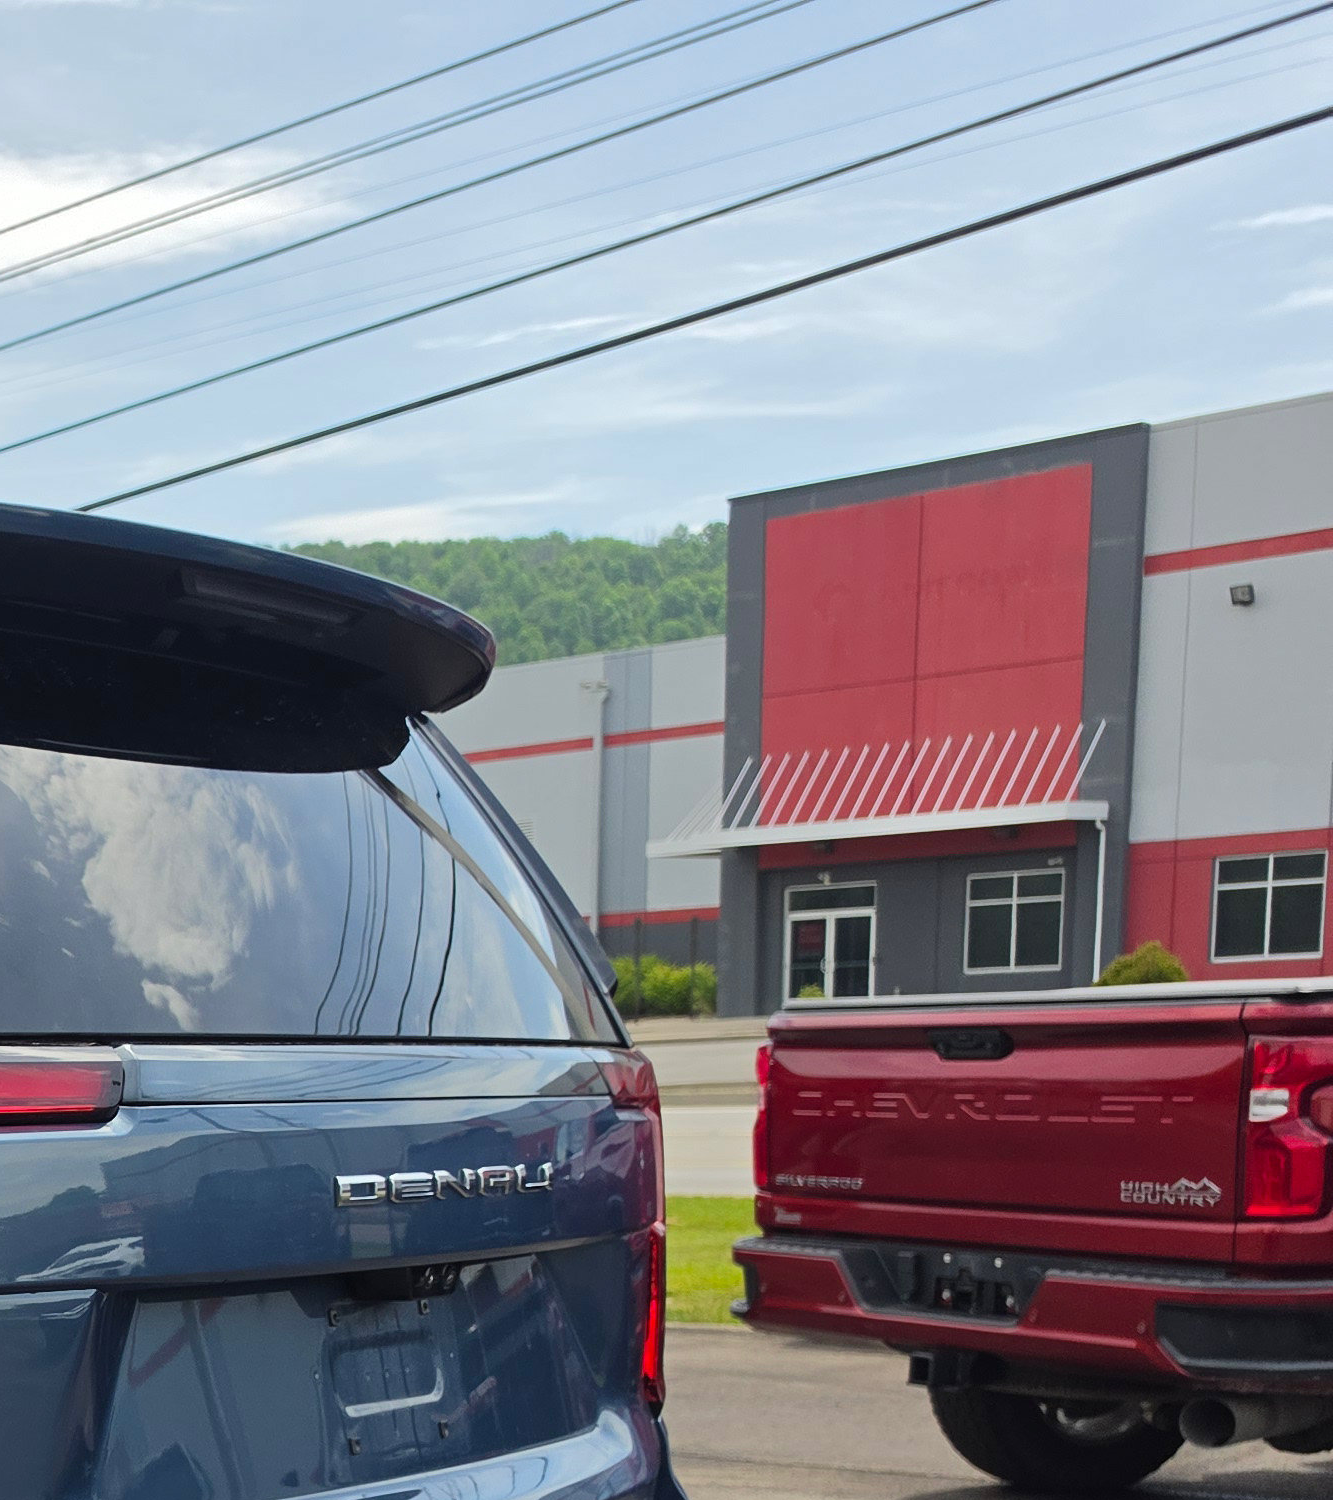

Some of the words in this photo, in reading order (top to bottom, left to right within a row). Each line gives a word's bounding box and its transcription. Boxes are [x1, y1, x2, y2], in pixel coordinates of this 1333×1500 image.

[791, 1090, 1194, 1124] CHEVROLET
[334, 1162, 555, 1207] DENALI
[1120, 1191, 1221, 1207] COUNTRY
